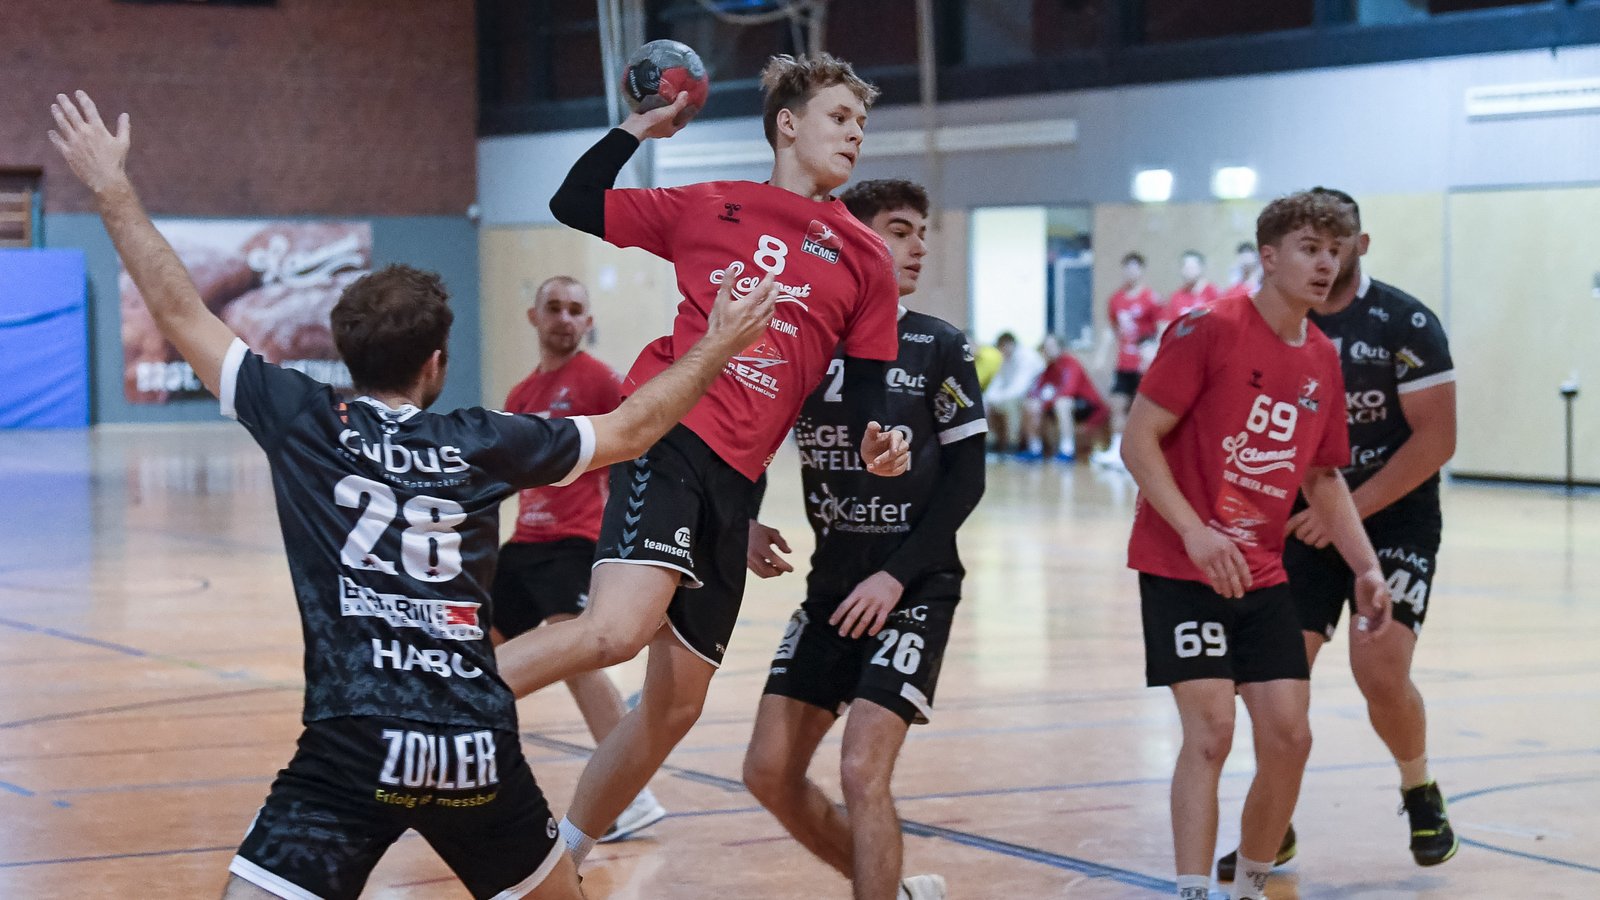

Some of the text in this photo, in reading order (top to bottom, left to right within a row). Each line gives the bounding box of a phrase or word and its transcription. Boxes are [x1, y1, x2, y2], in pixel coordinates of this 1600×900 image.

[754, 234, 788, 276] 8
[803, 241, 837, 262] HCME
[736, 276, 812, 298] Clment
[902, 332, 934, 344] HABO
[824, 358, 845, 402] 2
[1246, 394, 1298, 441] 69
[334, 474, 468, 583] 28
[834, 496, 912, 523] Kiefer
[1386, 568, 1428, 615] 44
[870, 628, 925, 675] 26
[1174, 621, 1228, 658] 69
